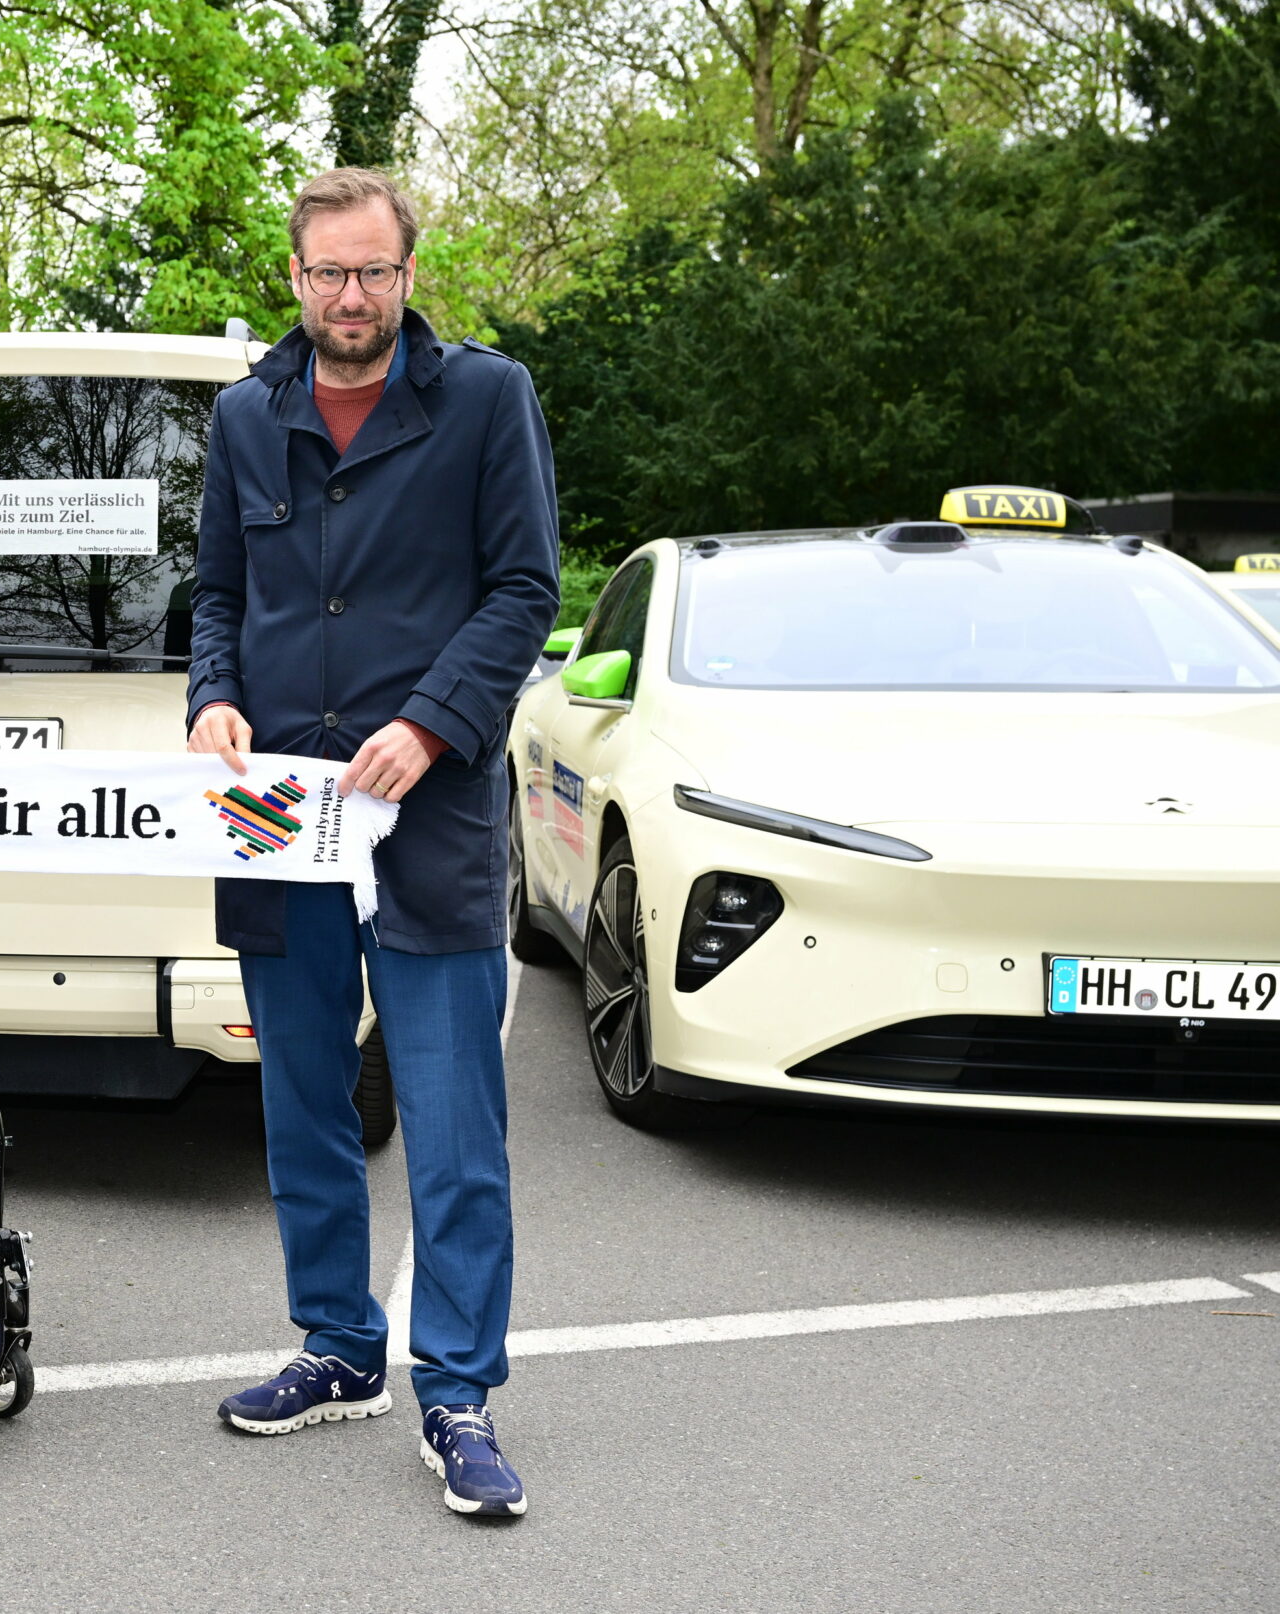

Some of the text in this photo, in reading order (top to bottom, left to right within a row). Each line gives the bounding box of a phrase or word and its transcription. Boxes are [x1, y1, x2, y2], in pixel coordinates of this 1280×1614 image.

[25, 495, 54, 507] uns
[59, 493, 145, 507] verlässlich
[971, 494, 1050, 519] TAXI
[20, 513, 54, 523] zum
[59, 509, 95, 523] Ziel.
[26, 528, 64, 536] Hamburg.
[78, 545, 153, 553] hamburg-olympia.de
[57, 788, 177, 840] alle.
[313, 777, 335, 863] Paralympics
[328, 848, 339, 862] in
[1080, 967, 1277, 1011] HH CL 49
[1058, 990, 1070, 1004] D
[1190, 1019, 1205, 1027] NIO
